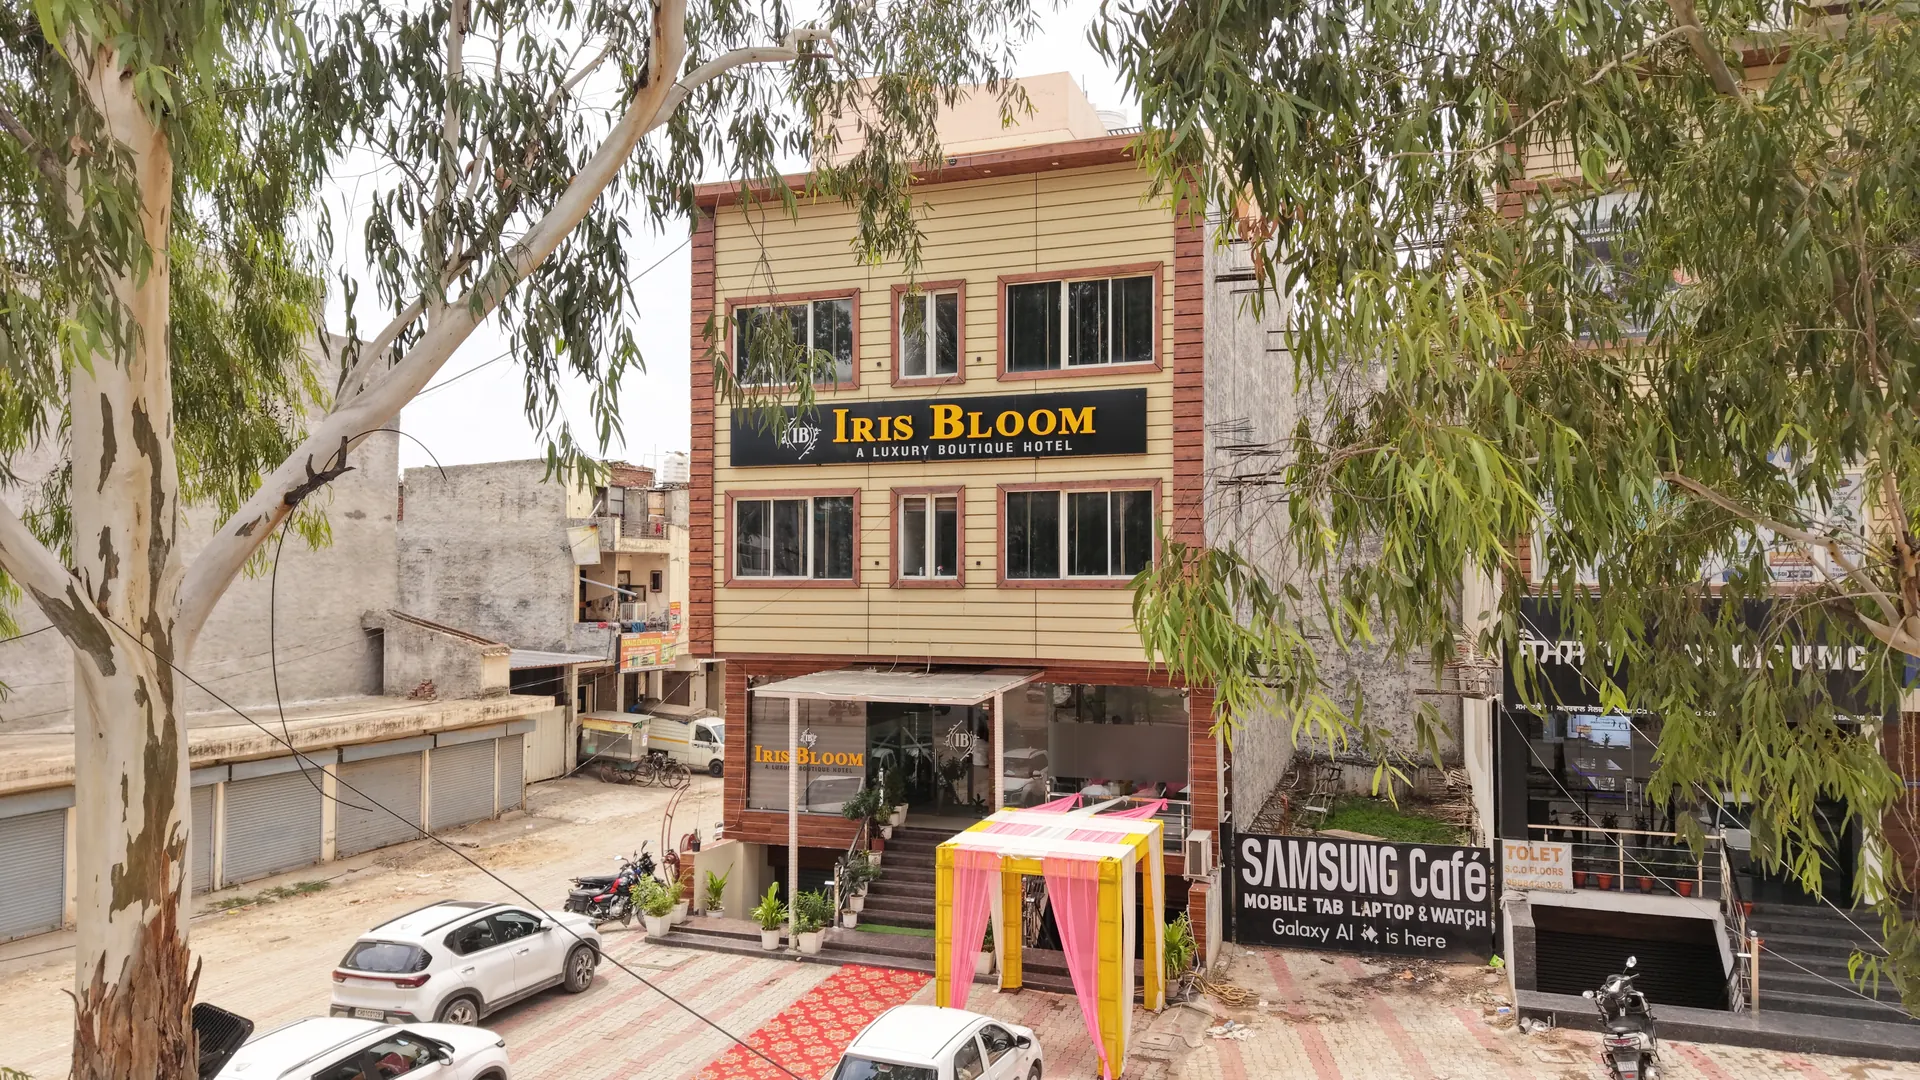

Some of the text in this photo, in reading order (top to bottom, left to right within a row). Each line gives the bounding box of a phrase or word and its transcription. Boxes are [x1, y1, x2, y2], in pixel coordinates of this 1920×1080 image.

[832, 404, 1097, 443] IRIS BLOOM
[792, 427, 809, 443] IB
[856, 440, 1073, 457] A LUXURY BOUTIQUE HOTEL
[955, 733, 969, 747] IB
[754, 745, 864, 767] IRIS BLOOM
[1504, 845, 1563, 862] TOLET
[1242, 838, 1487, 902] SAMSUNG Café
[1244, 893, 1487, 927] MOBILE TAB LAPTOP & WATCH
[1272, 918, 1447, 949] Galaxy AI is here
